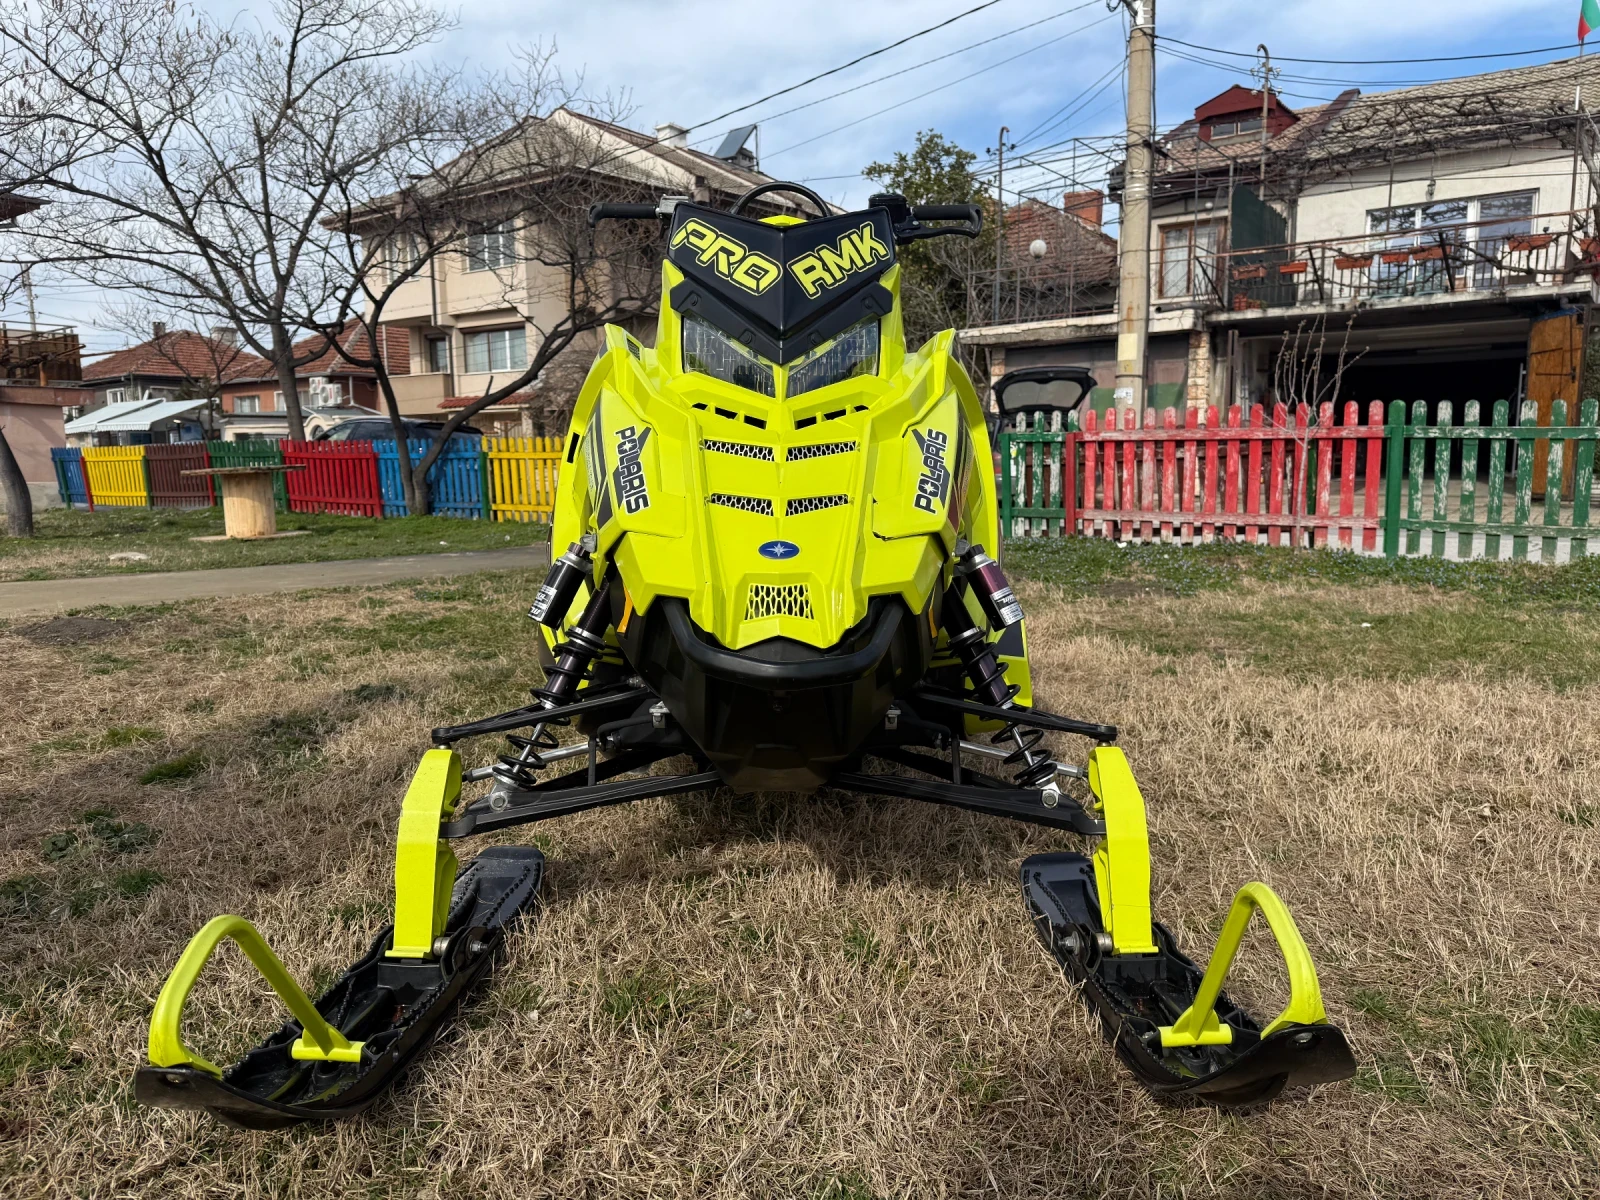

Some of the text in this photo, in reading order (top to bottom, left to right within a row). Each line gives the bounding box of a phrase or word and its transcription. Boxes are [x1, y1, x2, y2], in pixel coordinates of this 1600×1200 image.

[670, 218, 890, 299] PRO RMK
[614, 425, 650, 514] POLARIS
[913, 428, 948, 514] POLARIS
